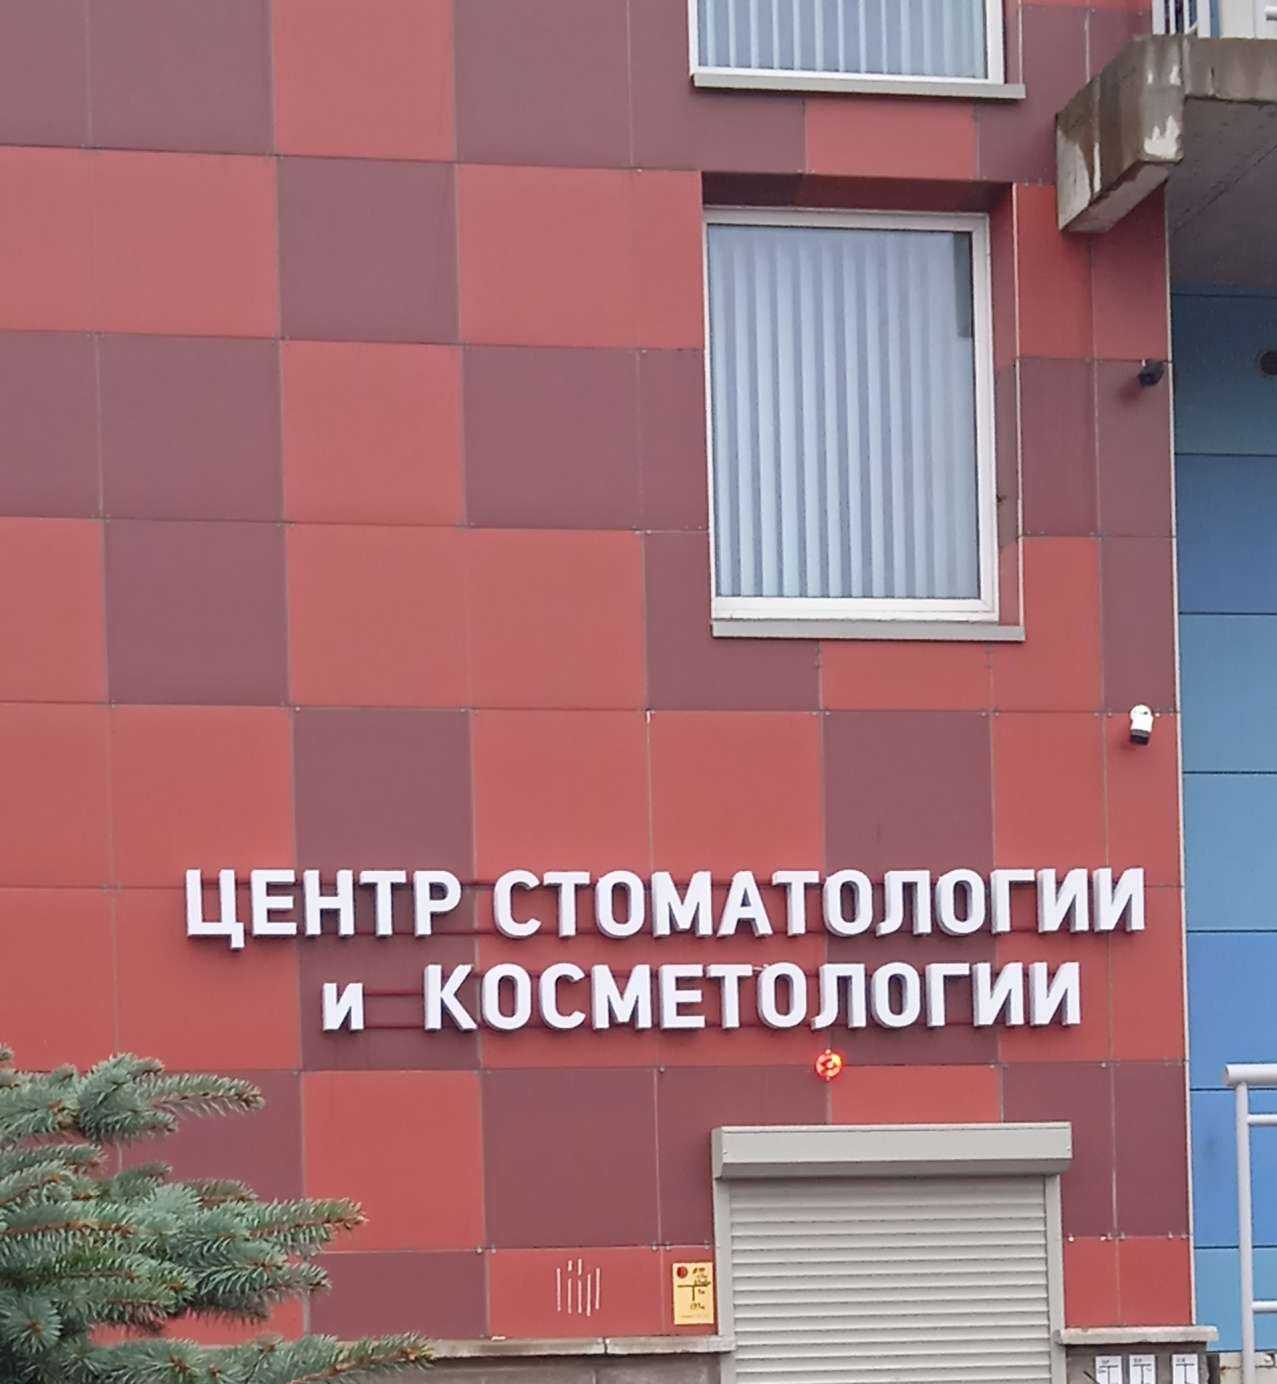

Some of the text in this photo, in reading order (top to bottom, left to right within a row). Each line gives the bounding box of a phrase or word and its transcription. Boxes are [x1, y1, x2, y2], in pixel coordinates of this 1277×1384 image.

[186, 867, 1146, 949] ЦЕНТР СТОМАТОЛОГИИ
[321, 961, 1082, 1032] и КОСМЕТОЛОГИИ
